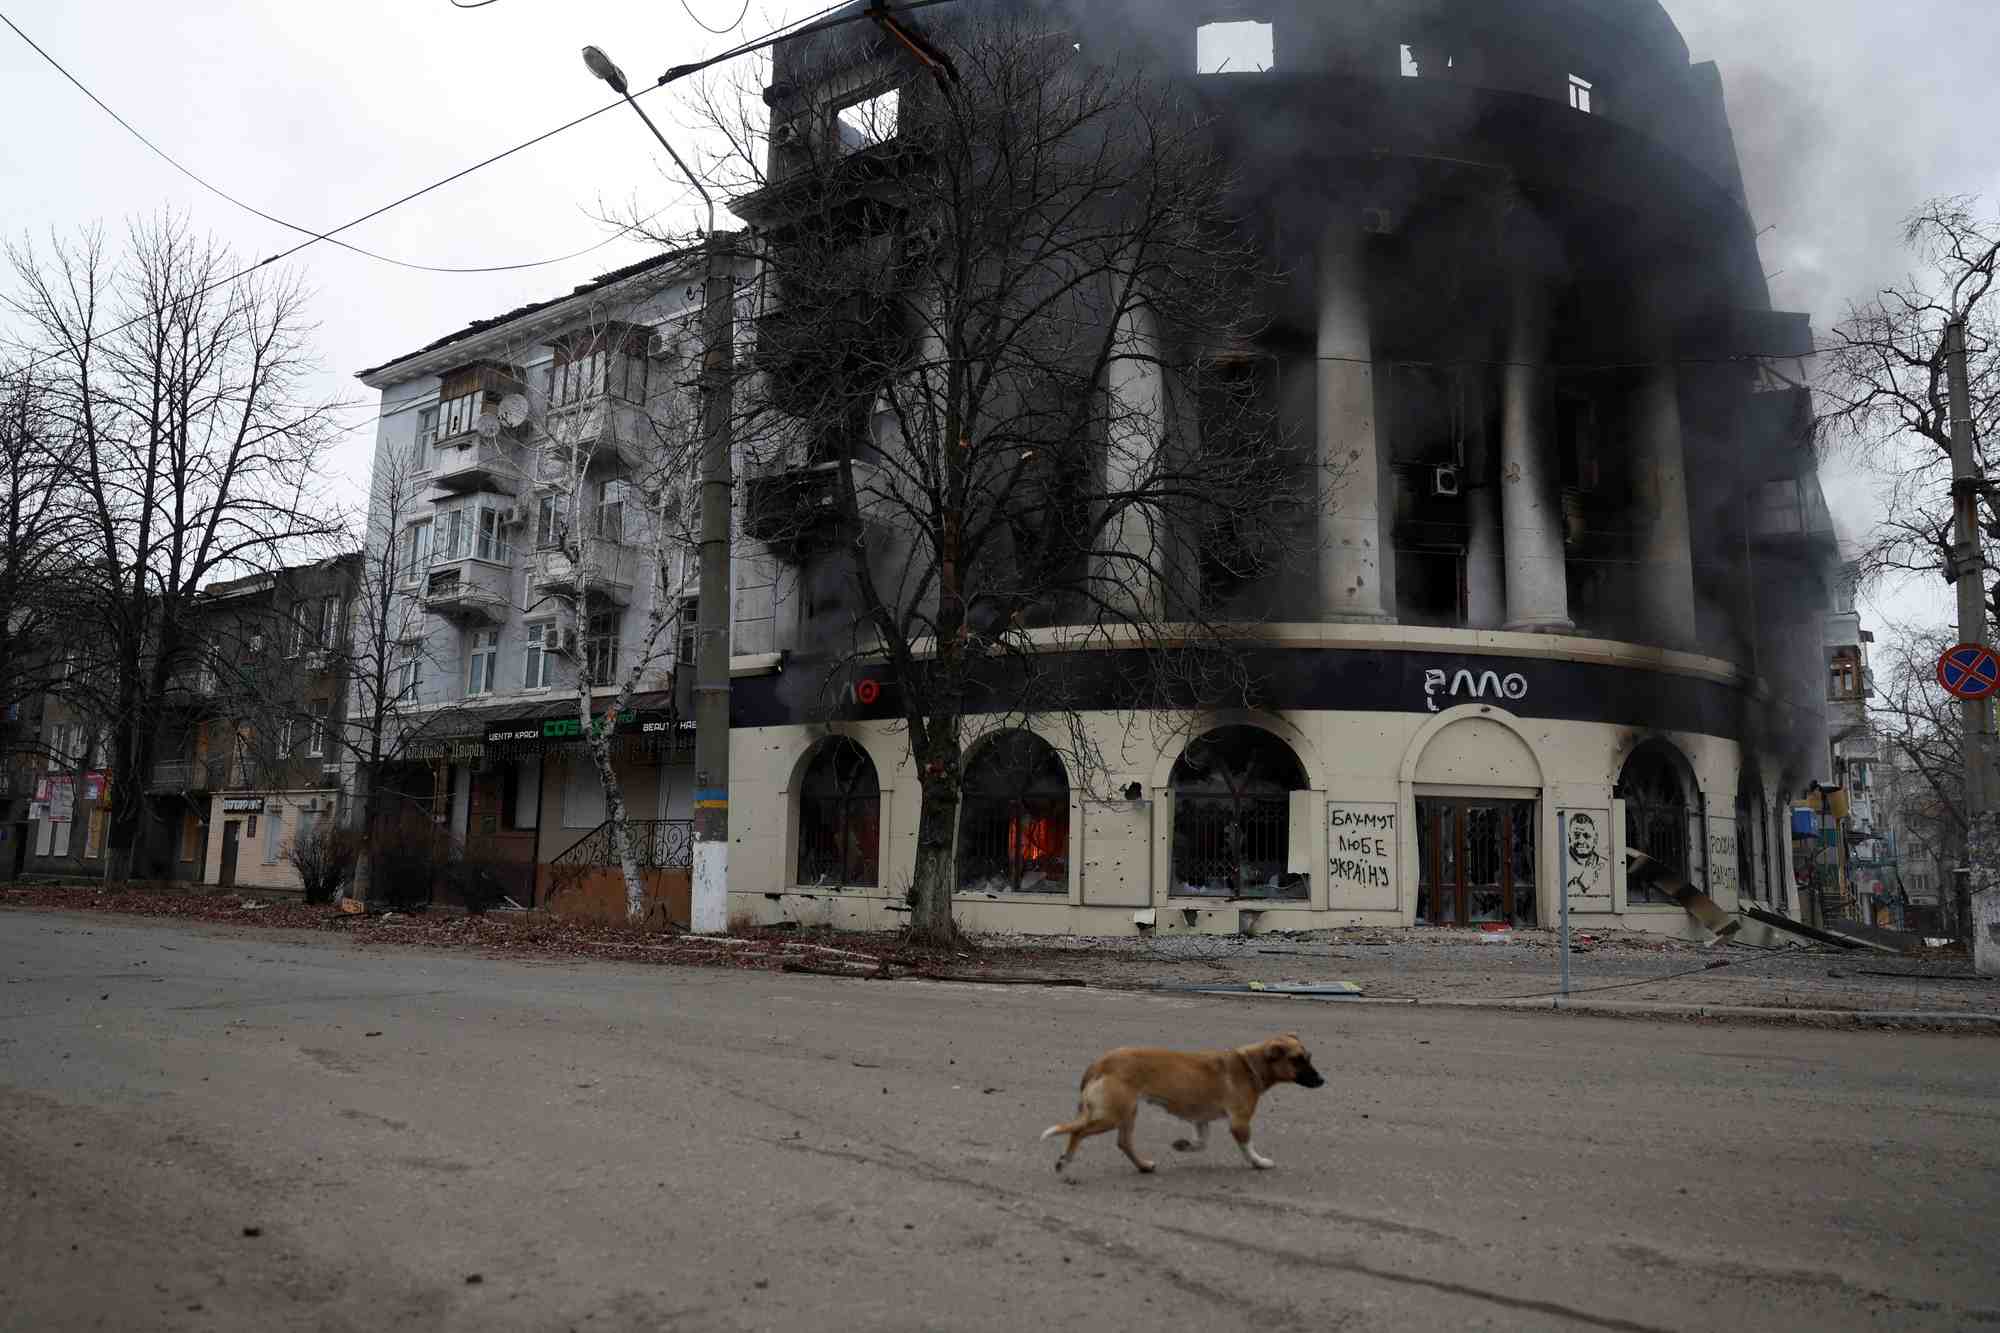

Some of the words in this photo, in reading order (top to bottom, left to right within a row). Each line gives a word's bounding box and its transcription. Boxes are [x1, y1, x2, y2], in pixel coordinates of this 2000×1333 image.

[488, 731, 513, 742] ЦЕНТР
[1332, 809, 1395, 830] БАХМУТ
[1339, 835, 1388, 857] ЛЮБЕ
[1329, 857, 1390, 888] УКРАЇНУ
